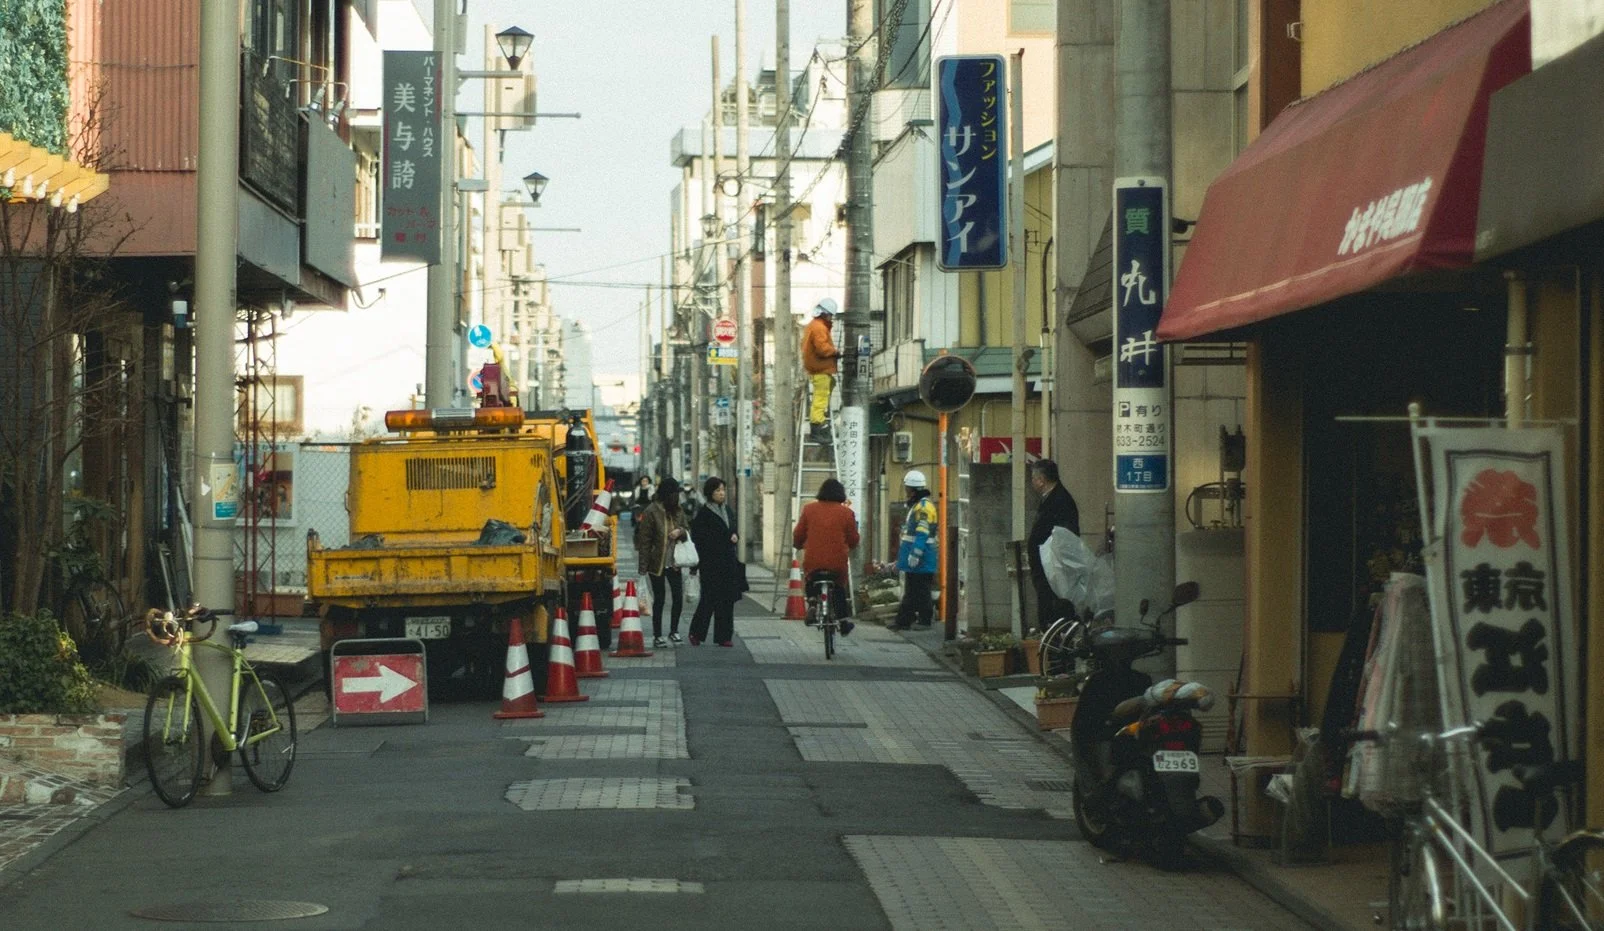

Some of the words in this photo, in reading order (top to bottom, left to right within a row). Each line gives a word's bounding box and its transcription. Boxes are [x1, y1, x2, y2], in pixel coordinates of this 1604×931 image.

[392, 82, 416, 189] 美与誇
[423, 56, 435, 157] パーマネント・ハウス
[980, 62, 997, 160] ファッション
[943, 125, 977, 253] サンアイ
[1125, 208, 1150, 235] 質
[1119, 260, 1158, 366] 丸井
[1135, 405, 1162, 417] 有り
[1127, 471, 1152, 482] 1丁目
[1459, 561, 1548, 614] 東京
